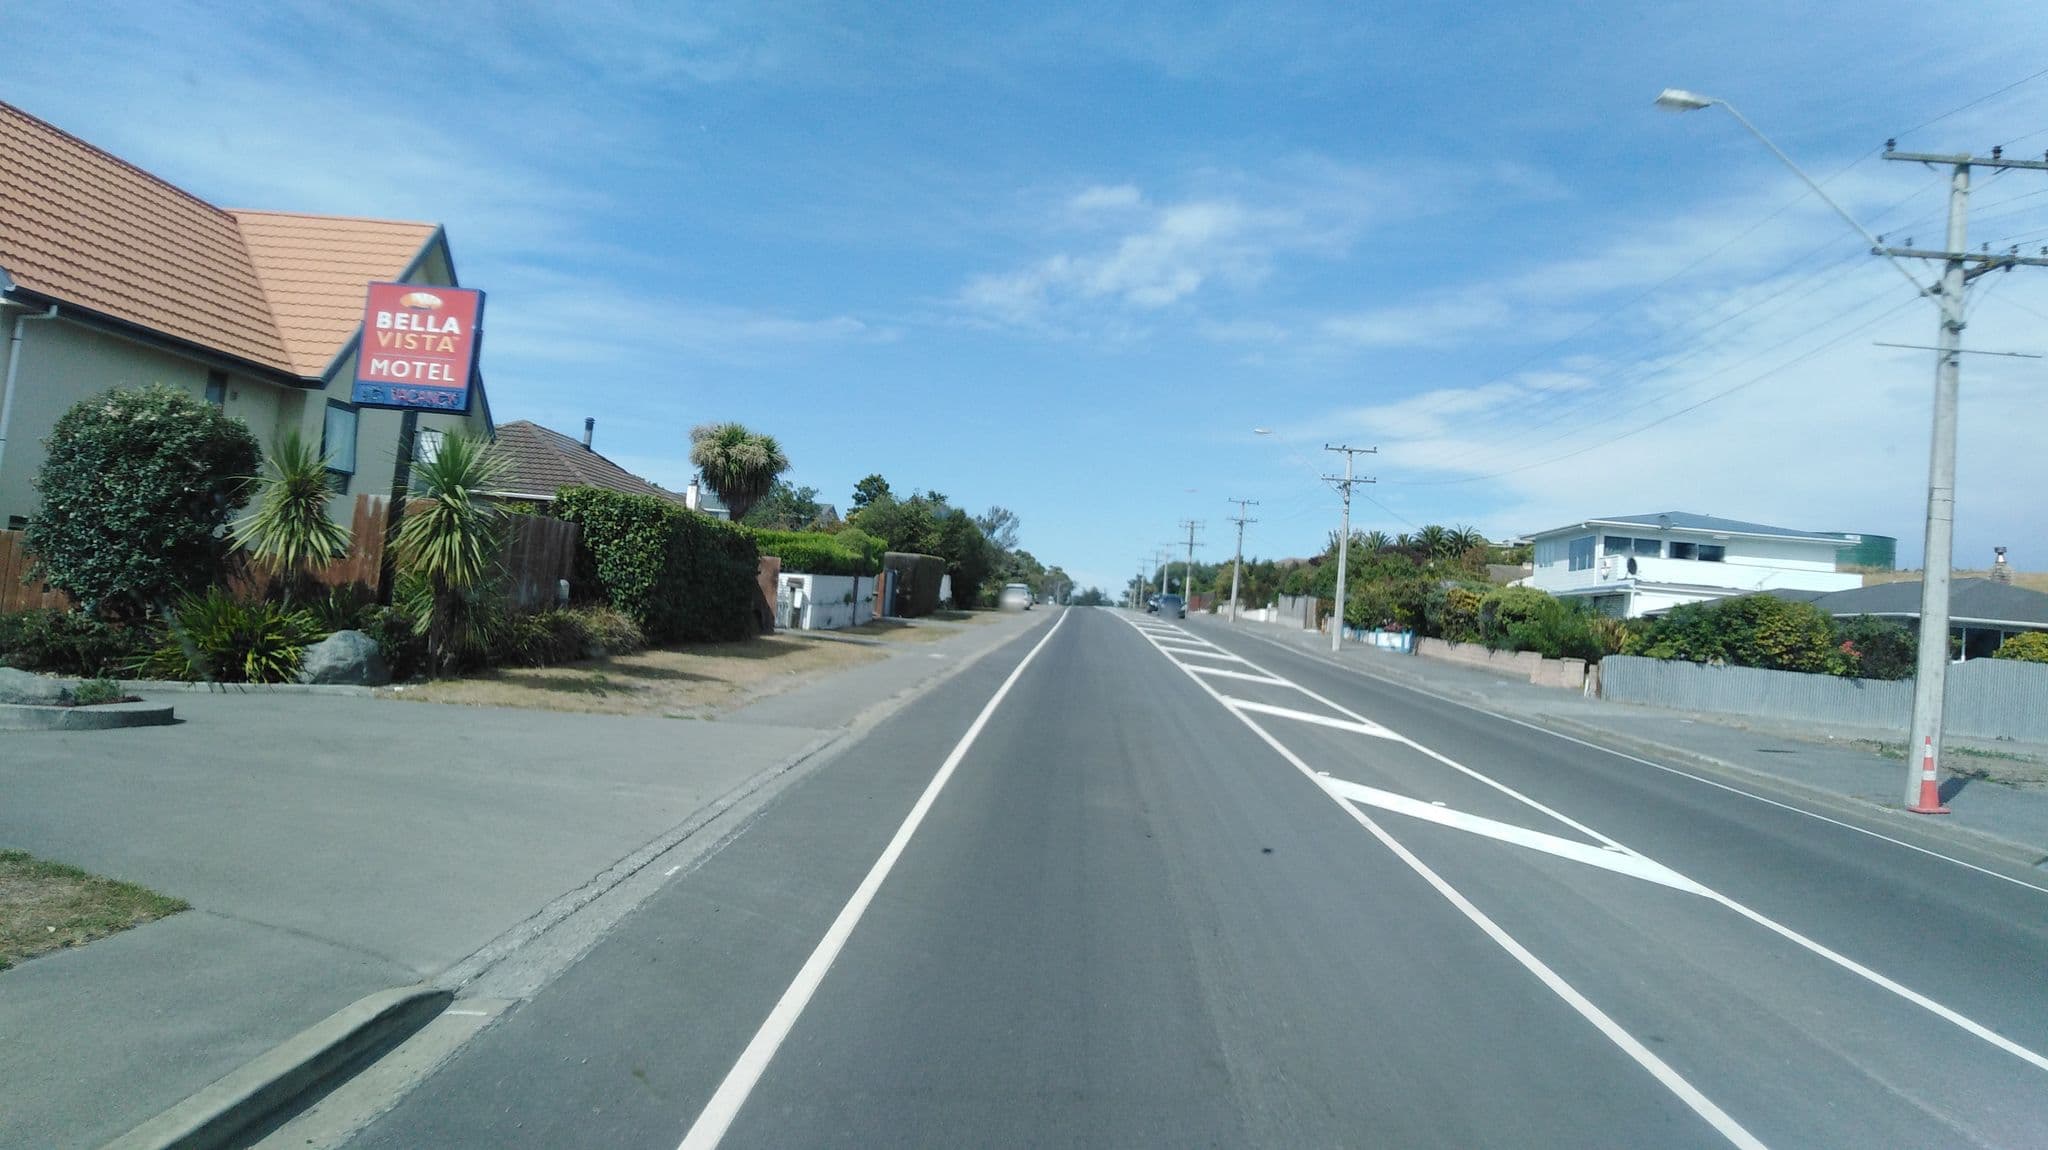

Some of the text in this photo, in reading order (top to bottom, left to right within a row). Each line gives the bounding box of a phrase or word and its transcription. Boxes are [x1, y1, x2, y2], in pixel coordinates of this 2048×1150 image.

[376, 311, 461, 335] BELLA
[377, 331, 455, 353] VISTA
[370, 358, 455, 381] MOTEL
